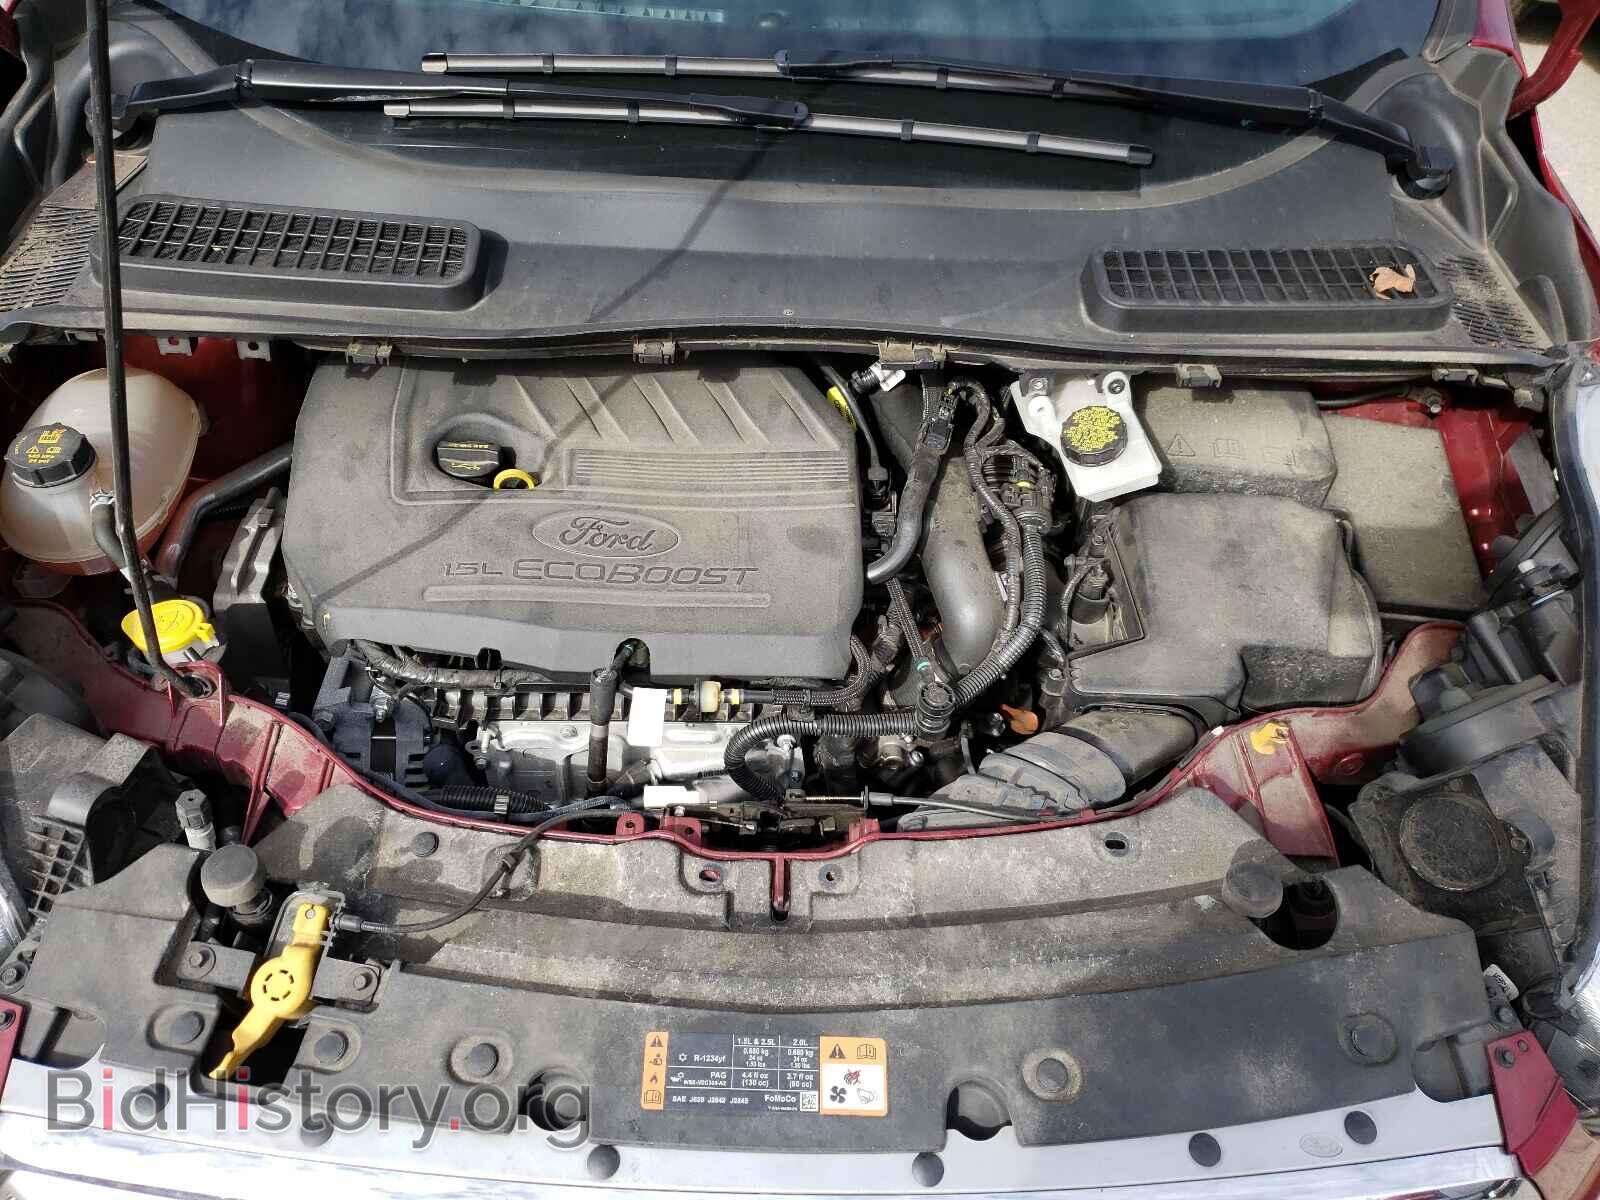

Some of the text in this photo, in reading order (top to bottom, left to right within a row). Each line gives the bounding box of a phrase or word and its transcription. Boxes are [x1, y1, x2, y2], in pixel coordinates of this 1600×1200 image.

[558, 516, 657, 551] Ford
[760, 1048, 769, 1057] kg
[805, 1049, 814, 1058] kg
[693, 1054, 726, 1063] R-1234yf
[710, 1071, 727, 1079] PAG
[764, 1094, 797, 1103] FoMoCo
